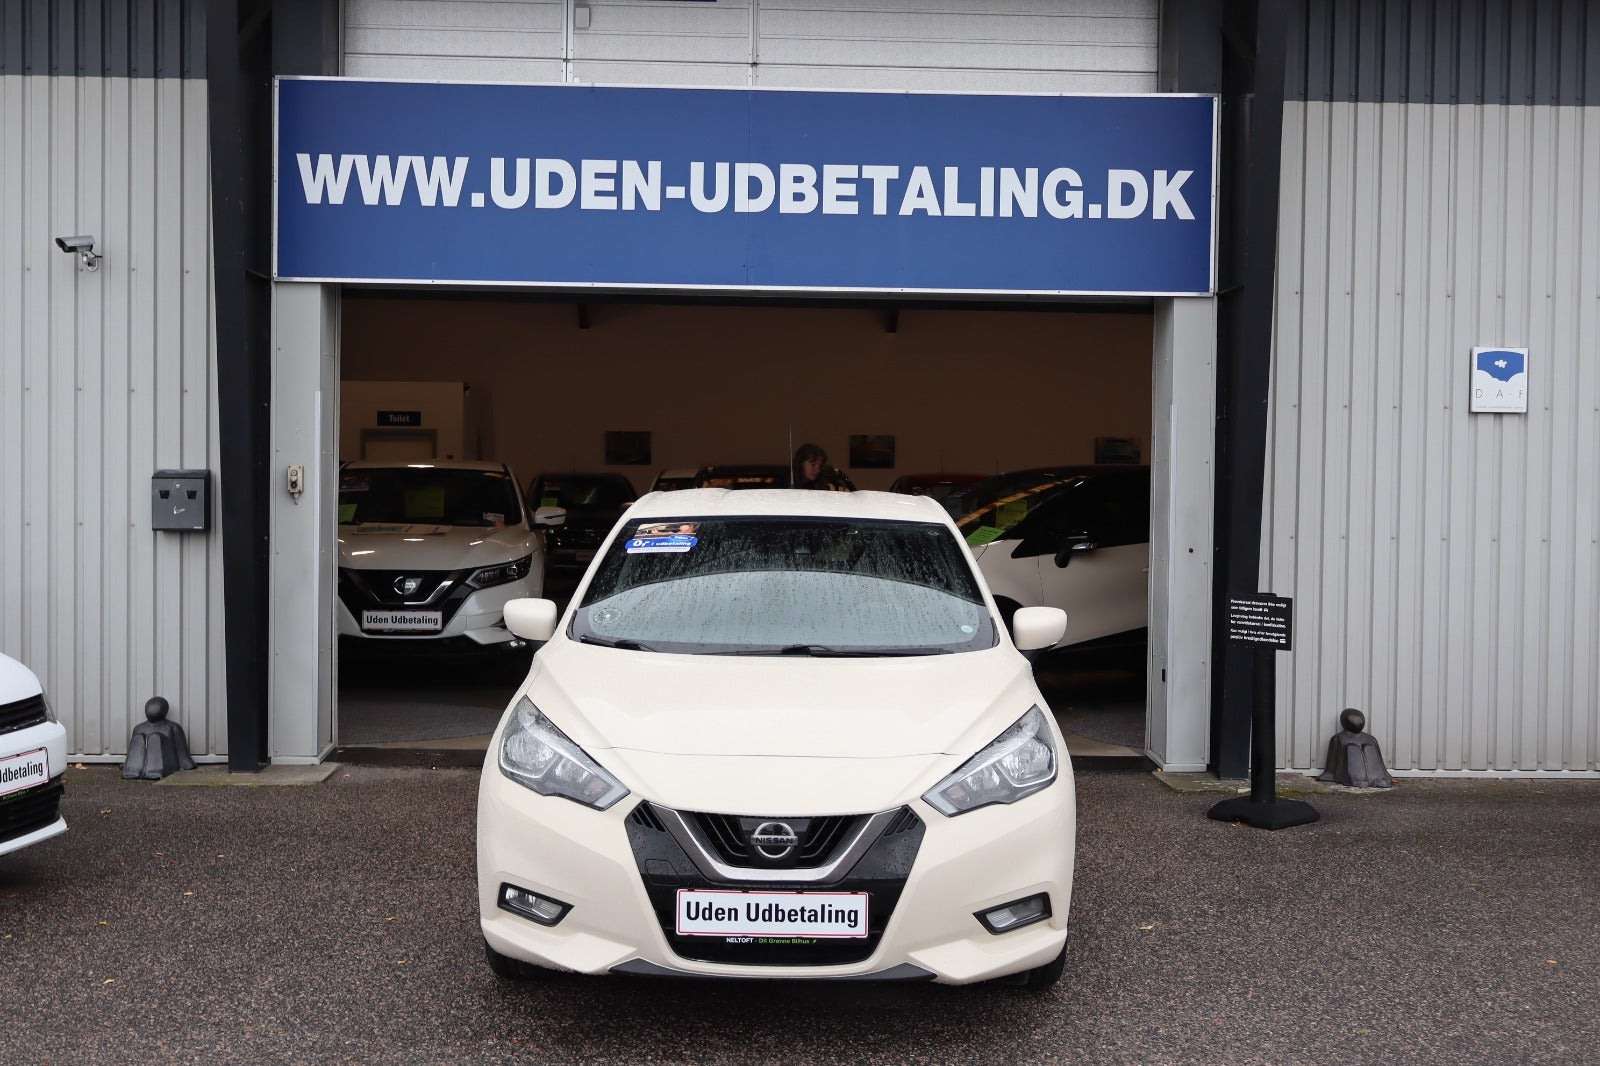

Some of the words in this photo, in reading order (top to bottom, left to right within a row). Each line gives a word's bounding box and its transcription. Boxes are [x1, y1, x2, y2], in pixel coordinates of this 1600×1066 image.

[296, 153, 1196, 220] WWW.UDEN-UDBETALING.DK
[389, 414, 409, 422] Toilet
[366, 615, 389, 624] Uden
[391, 615, 438, 626] Udbetaling
[0, 761, 43, 784] dbetaling
[686, 901, 739, 922] Uden
[746, 902, 859, 928] Udbetaling
